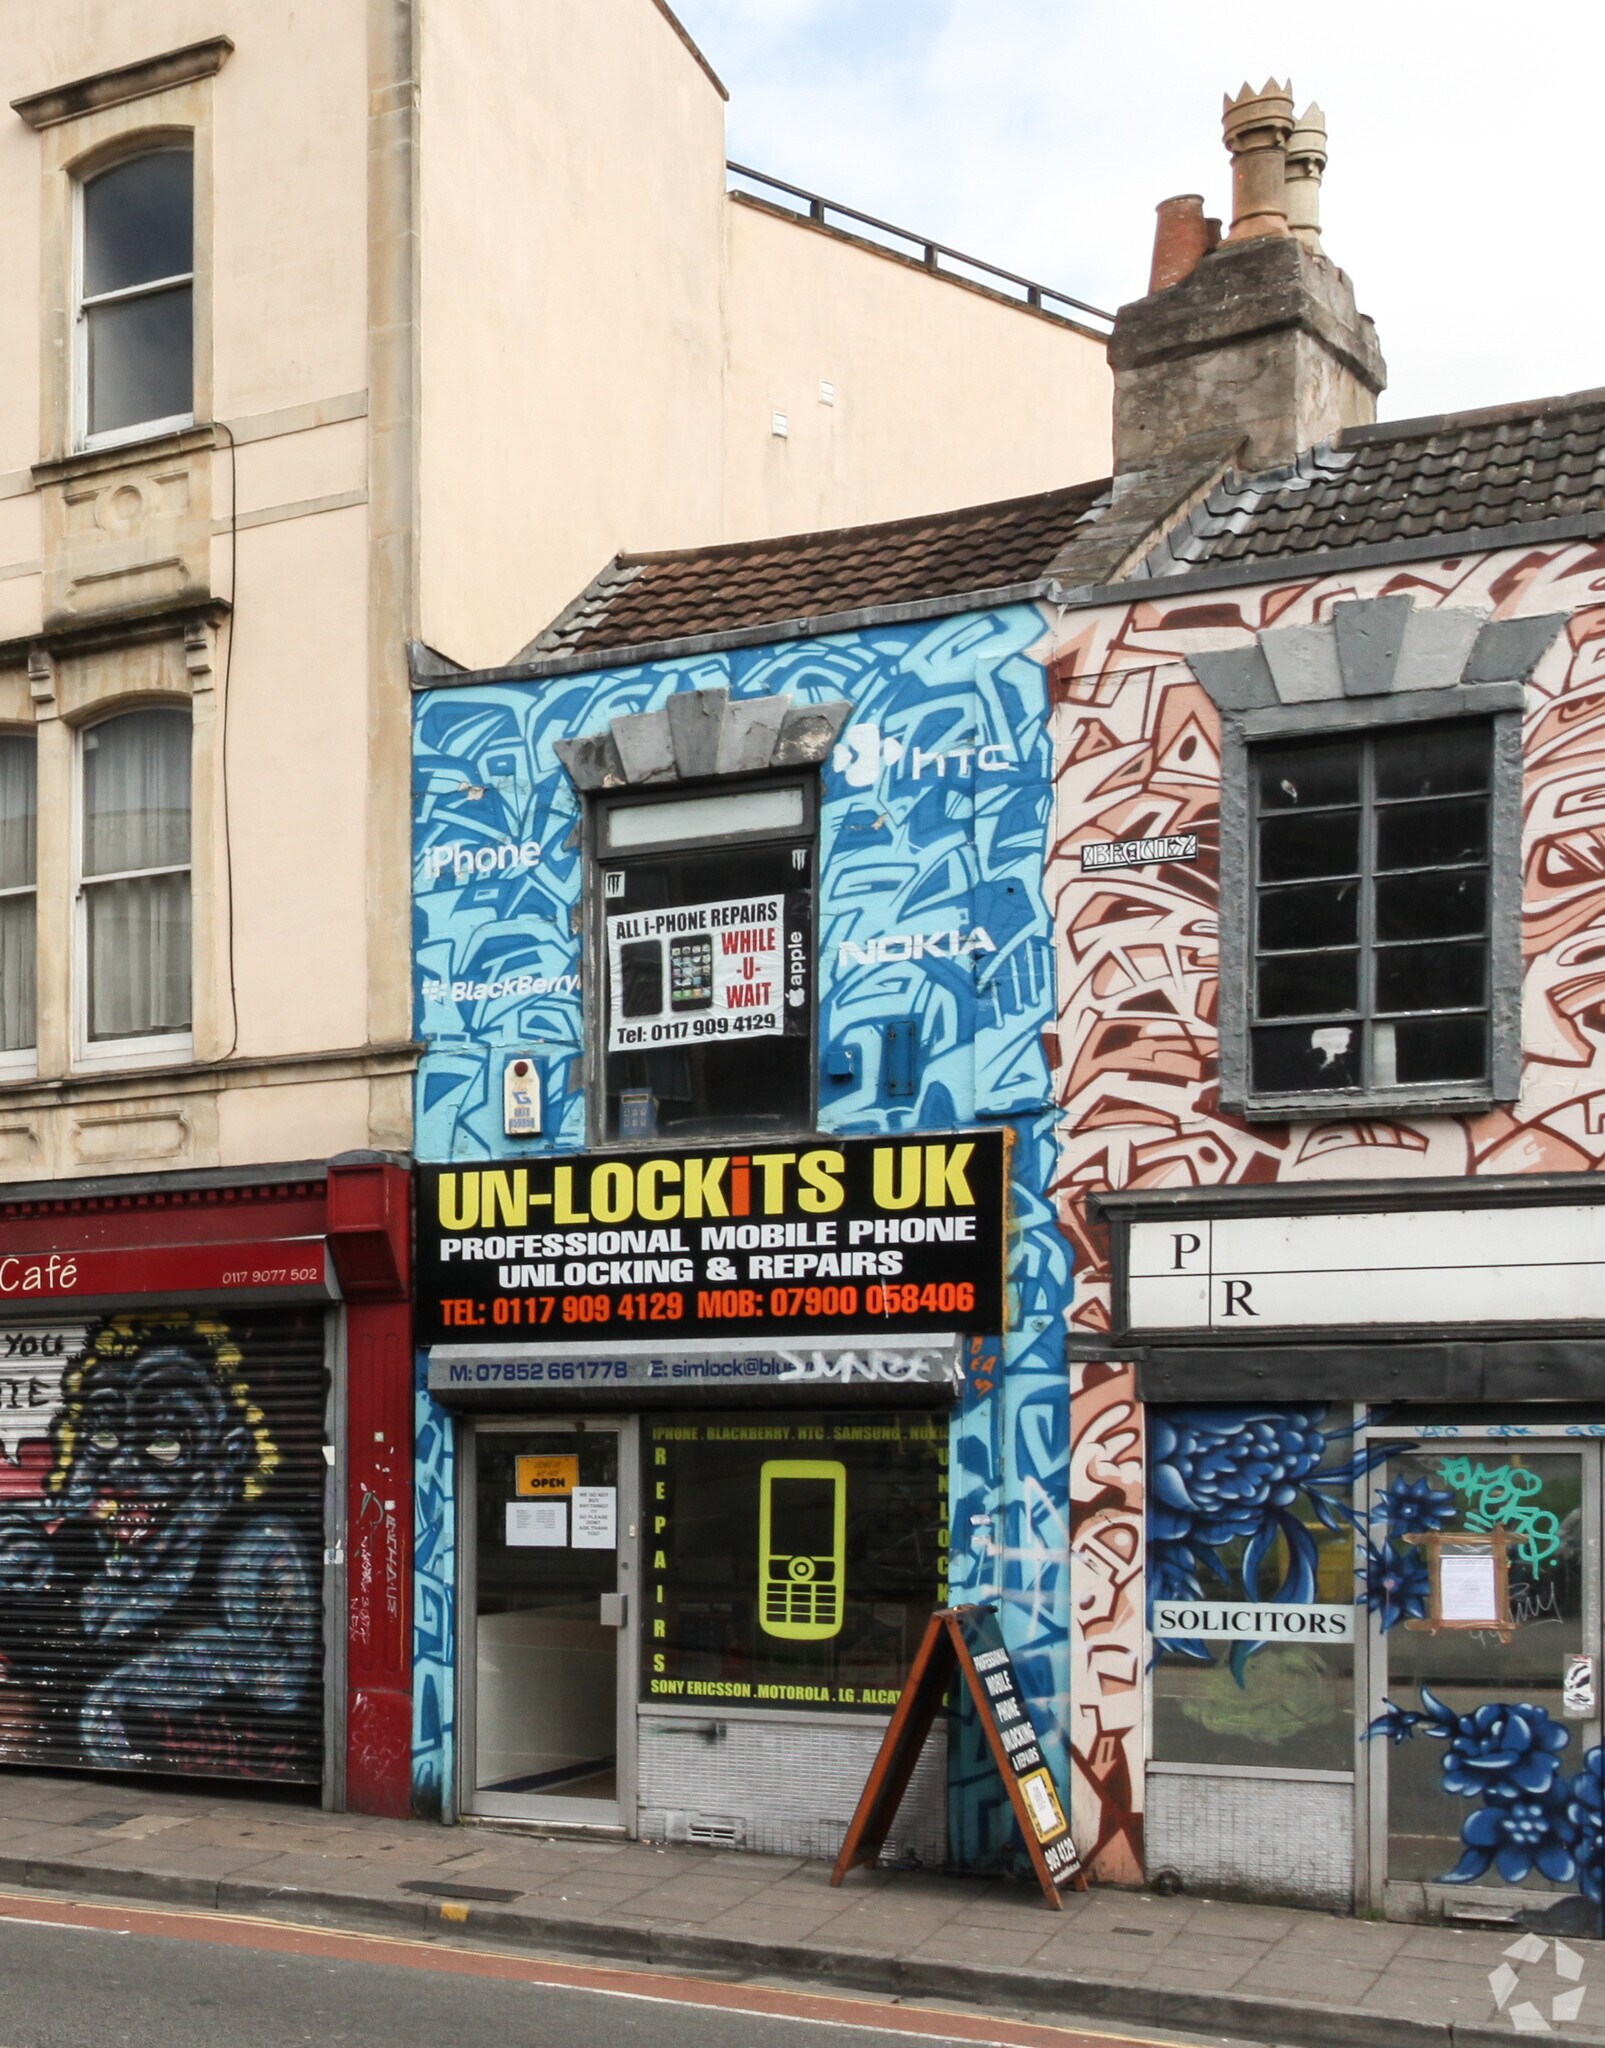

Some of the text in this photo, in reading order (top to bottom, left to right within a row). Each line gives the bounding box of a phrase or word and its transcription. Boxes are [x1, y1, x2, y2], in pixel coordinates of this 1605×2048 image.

[423, 841, 541, 880] iPhone
[616, 901, 778, 941] ALL i-PHONE REPAIRS
[721, 927, 776, 955] WHILE
[790, 931, 806, 985] apple
[838, 926, 997, 968] NOKIA
[451, 973, 579, 1003] BlackBerry
[726, 982, 772, 1009] WAIT
[617, 1013, 776, 1044] Tel: 0117 909 4129
[873, 1143, 976, 1210] UK
[440, 1216, 976, 1262] PROFESSIONAL MOBILE PHONE
[1170, 1233, 1201, 1270] P
[0, 1255, 78, 1292] Café
[222, 1268, 318, 1284] 0117 9077 502
[498, 1250, 904, 1288] UNLOCKING & REPAIRS
[440, 1282, 975, 1326] TEL: 0117 909 4129 MOB: 07900 058406
[1221, 1280, 1260, 1317] R
[450, 1365, 472, 1382] M:
[476, 1363, 543, 1382] 07852
[548, 1361, 627, 1380] 661778
[651, 1360, 668, 1377] E:
[706, 1426, 790, 1441] BLACKBERRY
[530, 1477, 566, 1489] OPEN
[1159, 1609, 1347, 1636] SOLICITORS
[651, 1679, 684, 1695] SONY
[687, 1681, 751, 1698] ERICSSON
[839, 1688, 855, 1702] LG
